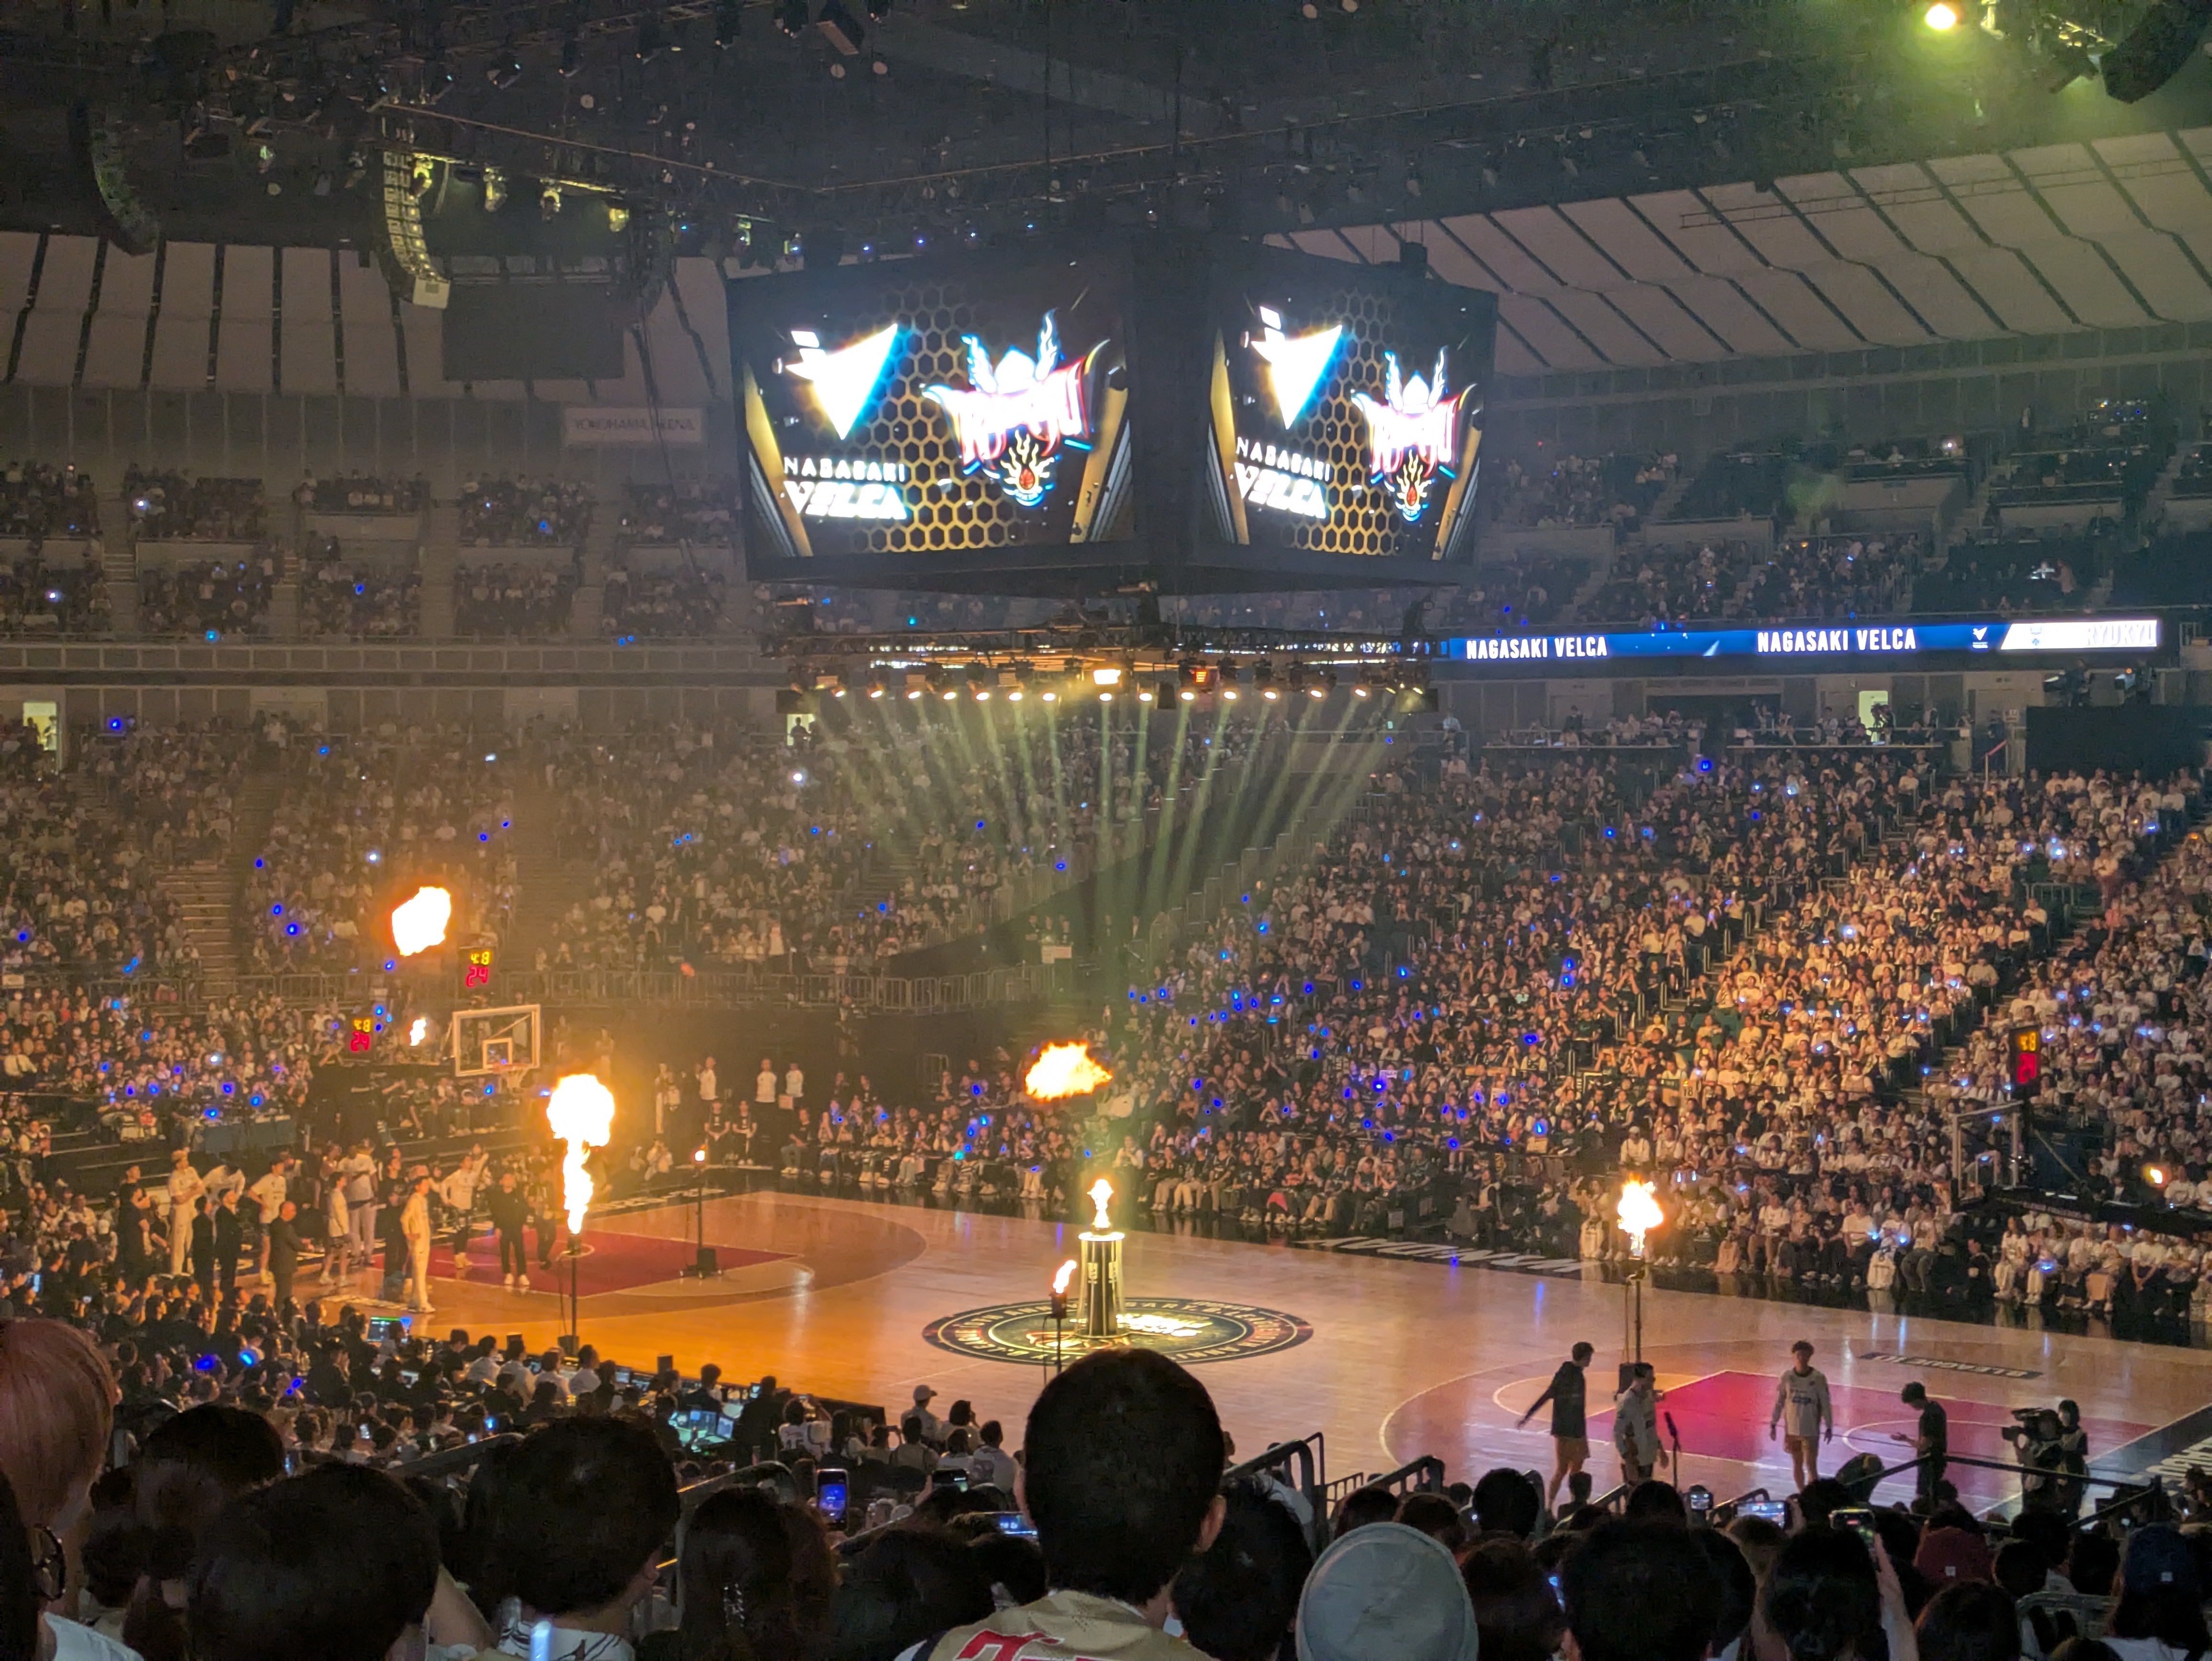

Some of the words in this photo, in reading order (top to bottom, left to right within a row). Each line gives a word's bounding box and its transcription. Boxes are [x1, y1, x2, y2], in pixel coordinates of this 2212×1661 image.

[1758, 630, 1848, 652] NAGASAKI
[1857, 628, 1916, 650] VELCA
[2087, 624, 2156, 645] RYUKYU
[1466, 638, 1548, 659] NAGASAKI
[1555, 636, 1607, 657] VELCA
[467, 966, 488, 987] 24
[351, 1031, 370, 1051] 24
[2017, 1053, 2036, 1083] 24
